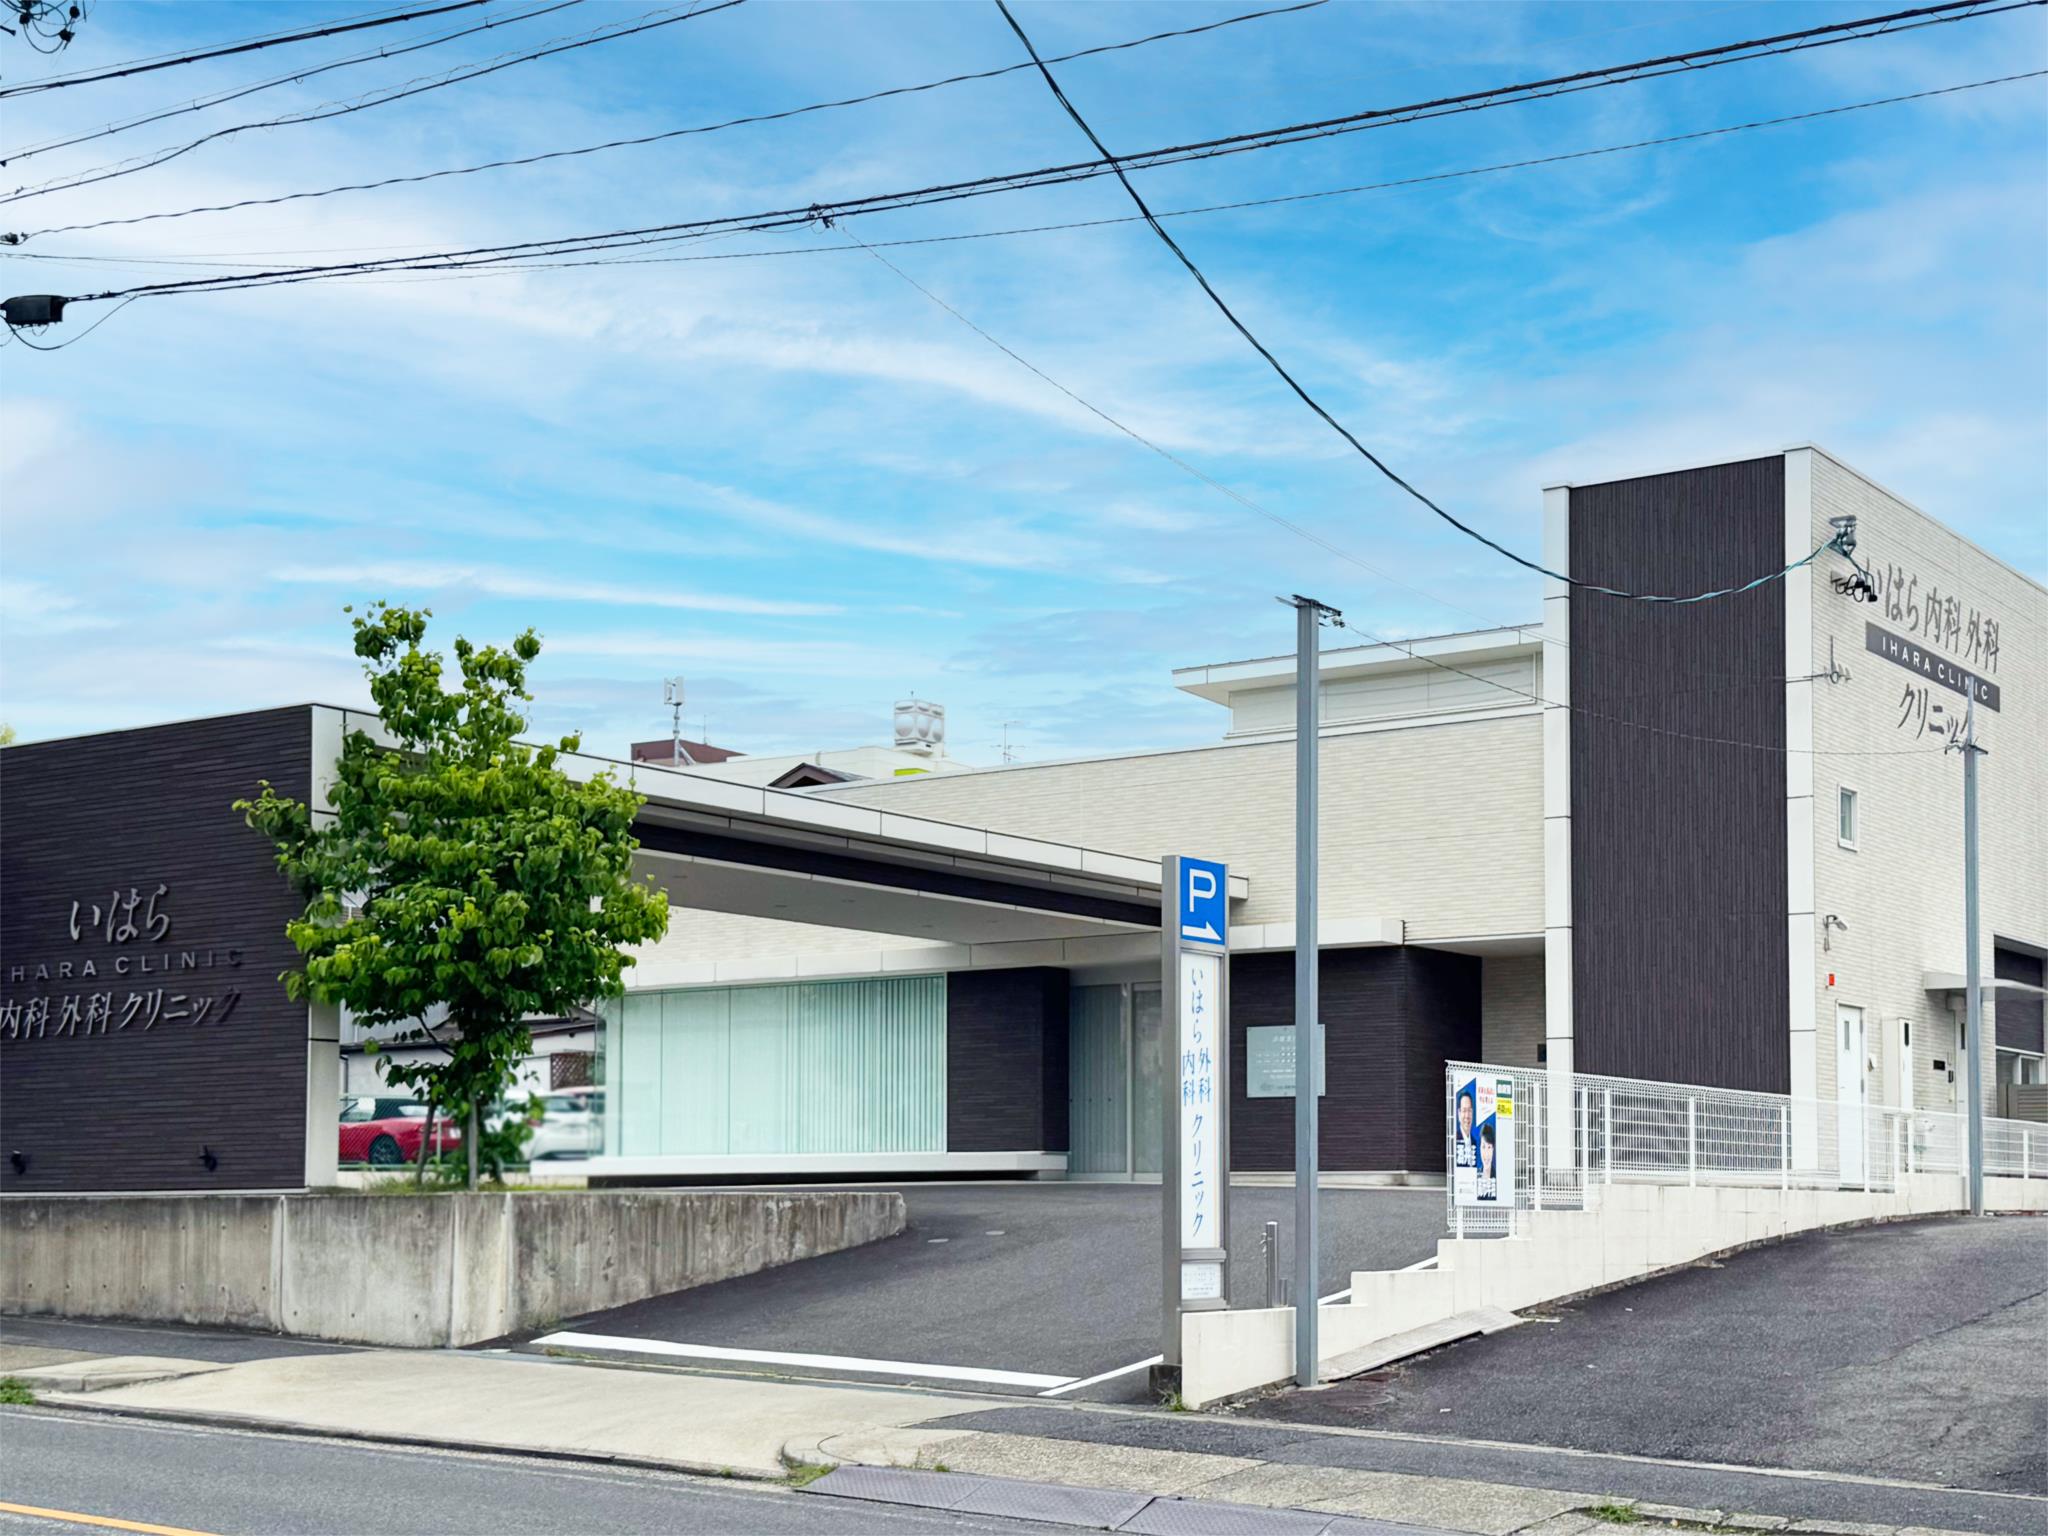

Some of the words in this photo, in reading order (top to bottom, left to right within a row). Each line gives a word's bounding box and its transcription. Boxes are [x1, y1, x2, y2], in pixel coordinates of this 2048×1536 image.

[1882, 636, 1931, 672] IHARA
[69, 883, 170, 943] いはら
[1189, 868, 1217, 912] P
[115, 949, 243, 974] CLINIC
[1191, 968, 1203, 1045] いはら
[1182, 1049, 1196, 1105] 内科
[1199, 1047, 1212, 1103] 外科
[1191, 1113, 1204, 1238] クリニック
